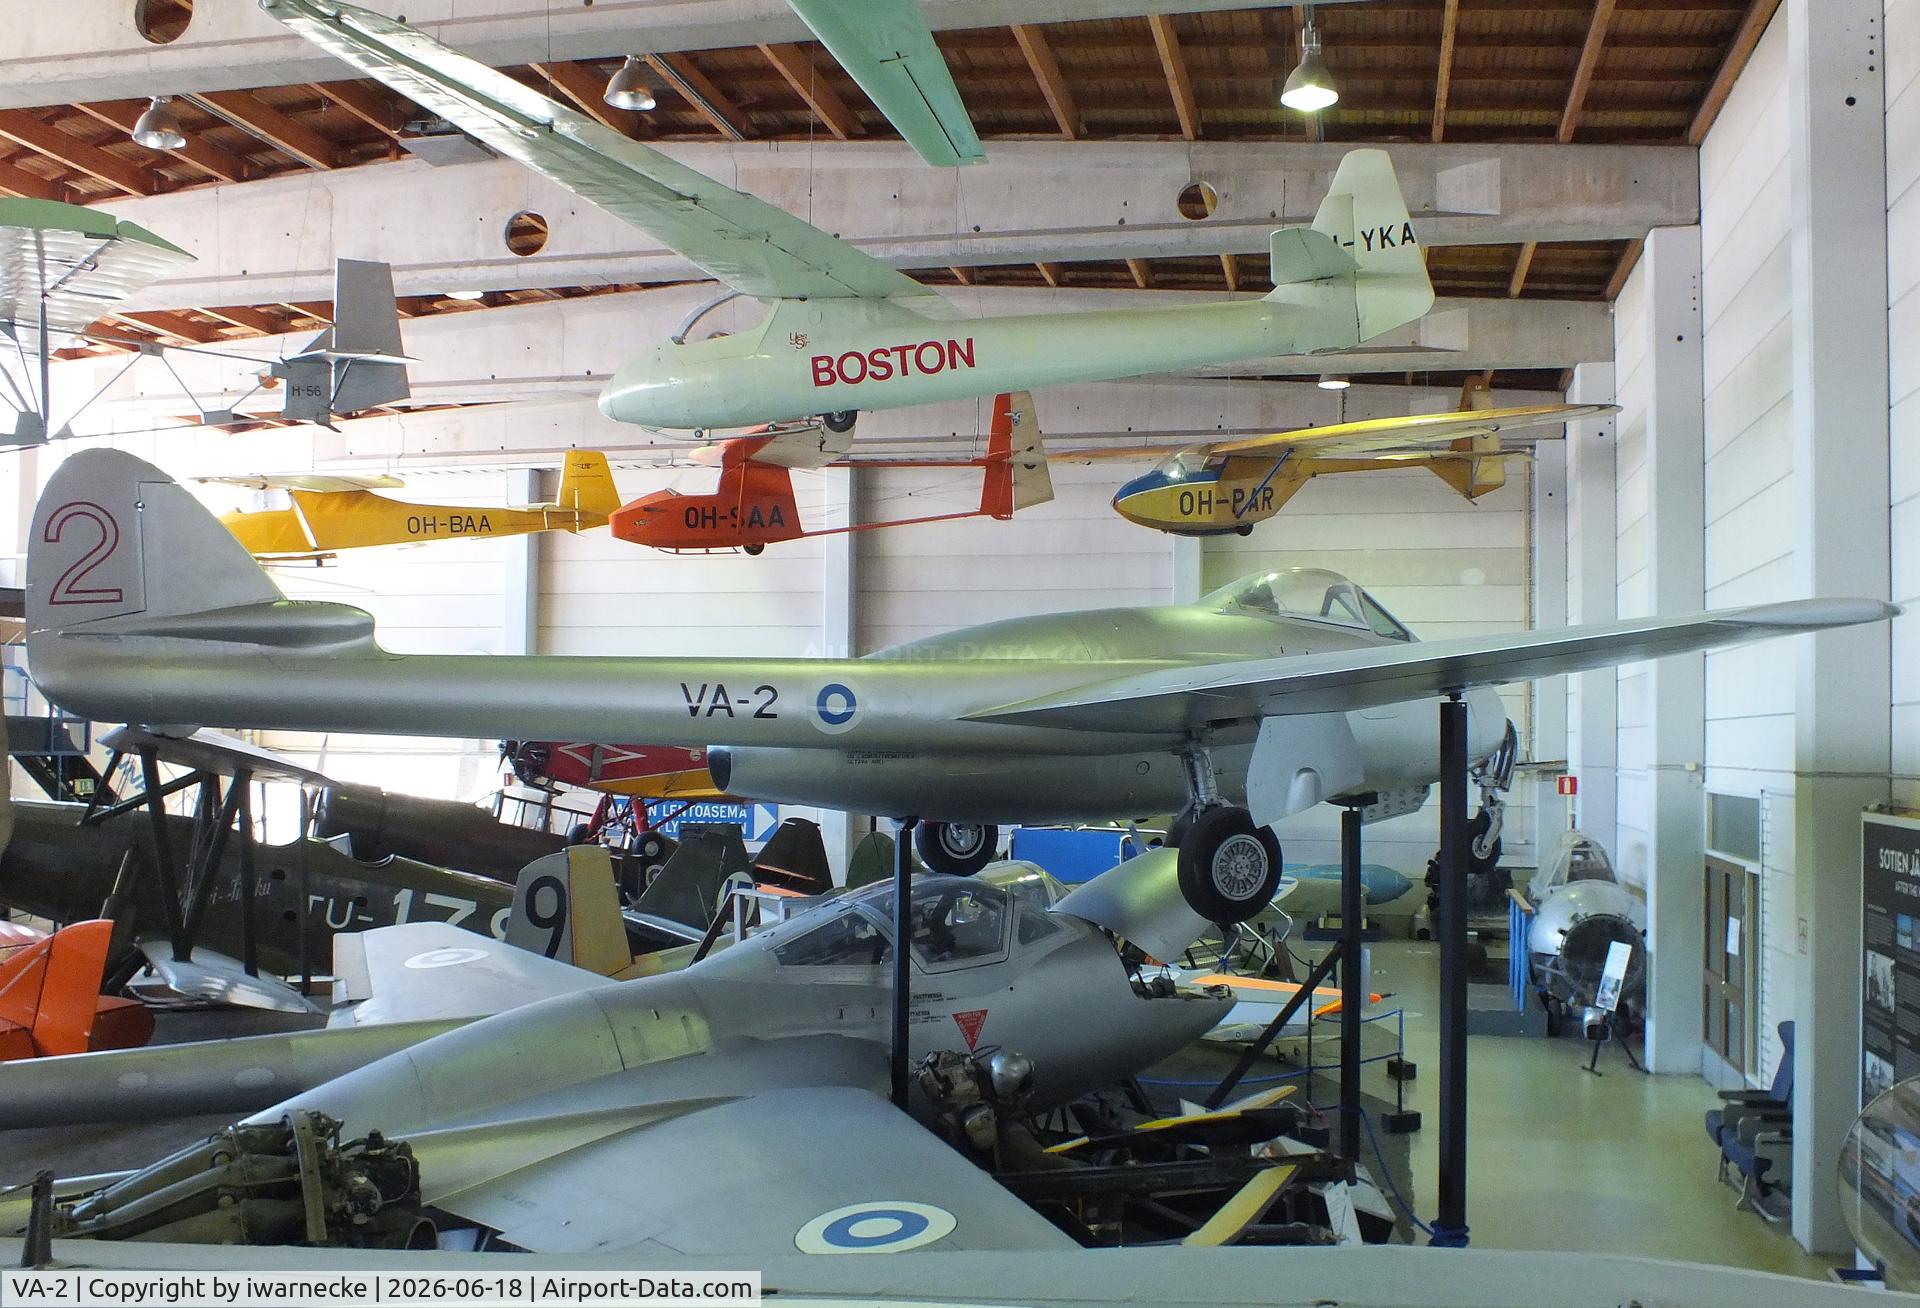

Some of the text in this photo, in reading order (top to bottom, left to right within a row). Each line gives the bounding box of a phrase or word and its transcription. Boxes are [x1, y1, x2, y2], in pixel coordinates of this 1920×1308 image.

[1333, 222, 1416, 252] -YKA
[811, 337, 976, 387] BOSTON
[1179, 486, 1274, 516] OH-PAR
[407, 515, 492, 534] OH-BAA
[684, 504, 785, 529] OH-SAA
[44, 501, 123, 605] 2
[680, 682, 779, 719] VA-2
[662, 803, 748, 819] LENTOASEMA
[1879, 847, 1909, 873] SOTIEN
[525, 875, 567, 959] 9
